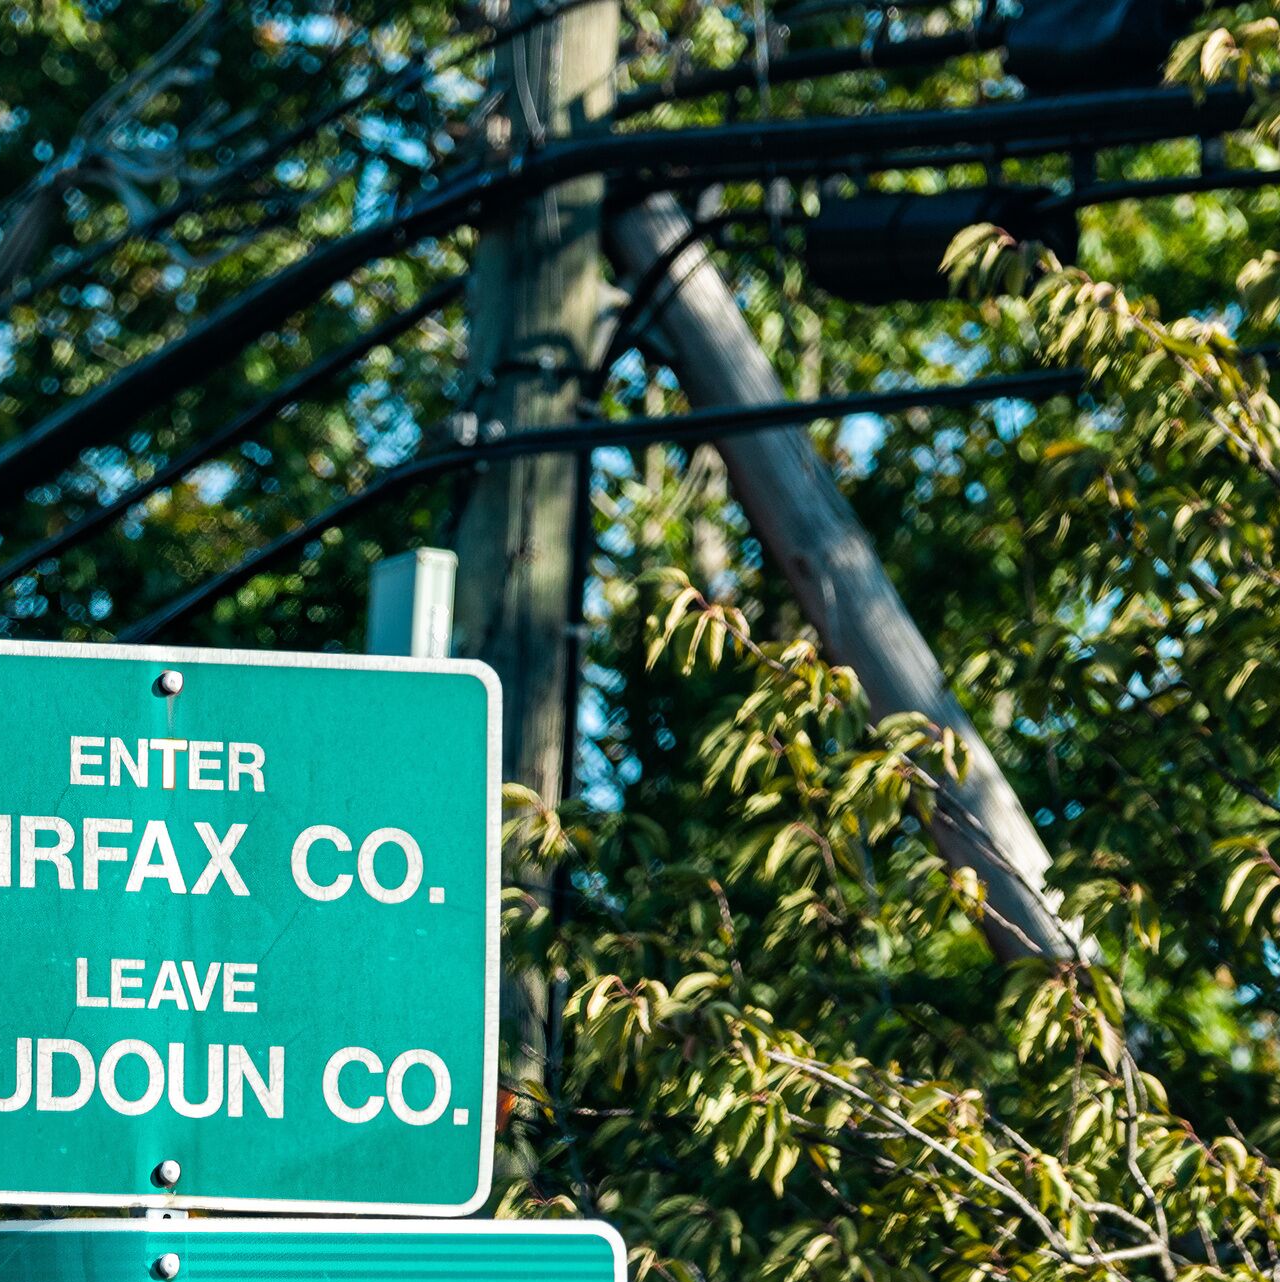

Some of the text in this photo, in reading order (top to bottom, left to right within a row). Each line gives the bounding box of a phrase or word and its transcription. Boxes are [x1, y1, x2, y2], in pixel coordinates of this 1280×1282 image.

[70, 736, 265, 792] ENTER
[291, 825, 444, 904] CO.
[76, 958, 257, 1012] LEAVE
[323, 1047, 469, 1126] CO.
